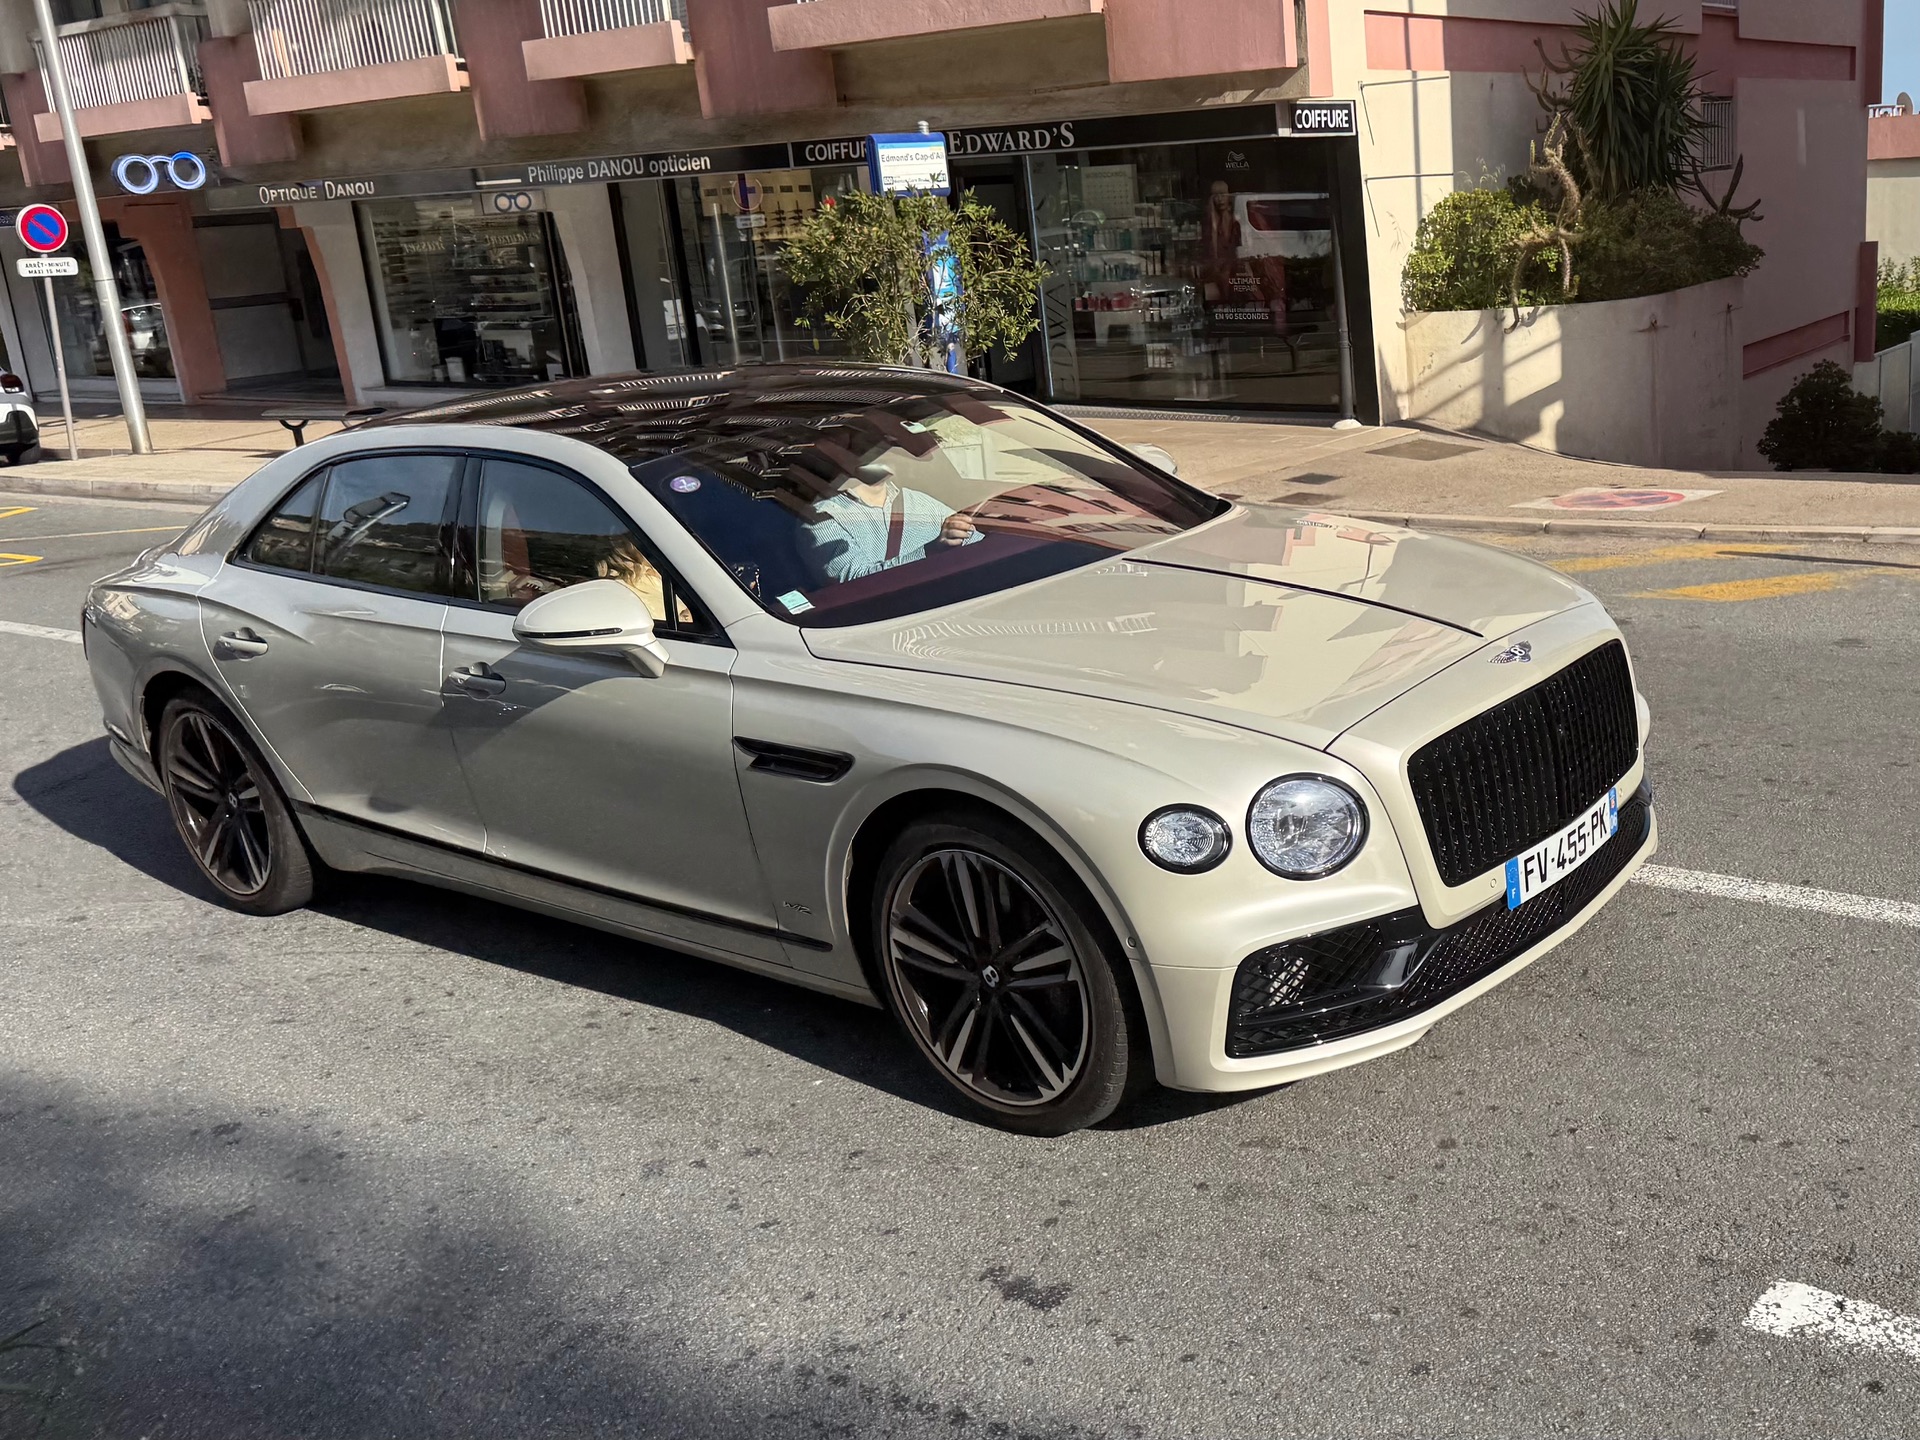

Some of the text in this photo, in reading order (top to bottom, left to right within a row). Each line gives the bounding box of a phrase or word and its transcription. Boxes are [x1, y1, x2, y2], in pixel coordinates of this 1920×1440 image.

[1295, 109, 1349, 128] COIFFURE
[946, 122, 1075, 155] EDWARD'S
[528, 154, 711, 184] Philippe DANOU opticien
[259, 180, 375, 204] OPTIQUE DANOU
[1523, 802, 1608, 894] FV-455-PK
